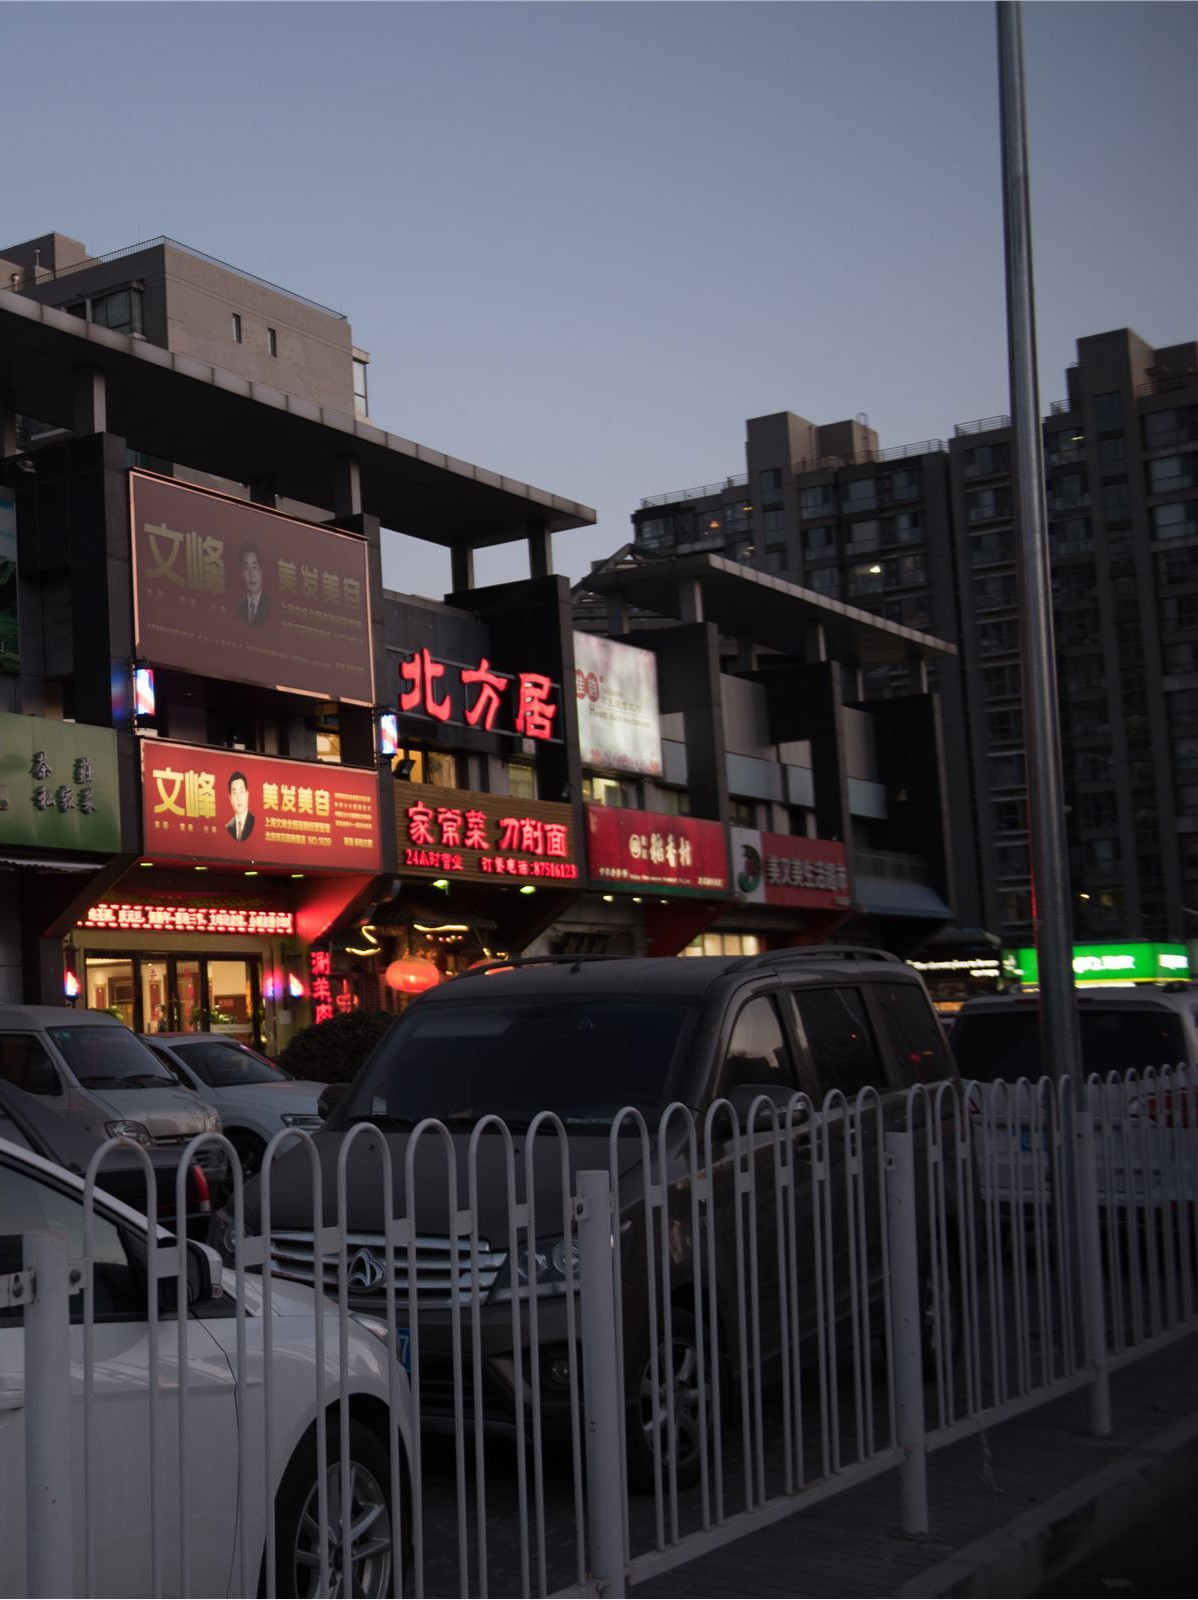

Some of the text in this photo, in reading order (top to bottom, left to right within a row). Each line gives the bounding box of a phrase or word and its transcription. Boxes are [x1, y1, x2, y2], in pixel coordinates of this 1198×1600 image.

[144, 522, 226, 594] 文峰
[277, 559, 362, 610] 美发美容
[401, 647, 556, 740] 北方居
[152, 767, 216, 818] 文峰
[263, 782, 330, 816] 美发美容
[408, 800, 568, 857] 家常菜 刀削面
[405, 848, 464, 871] 24小时营业
[311, 951, 333, 1024] 涮羊肉
